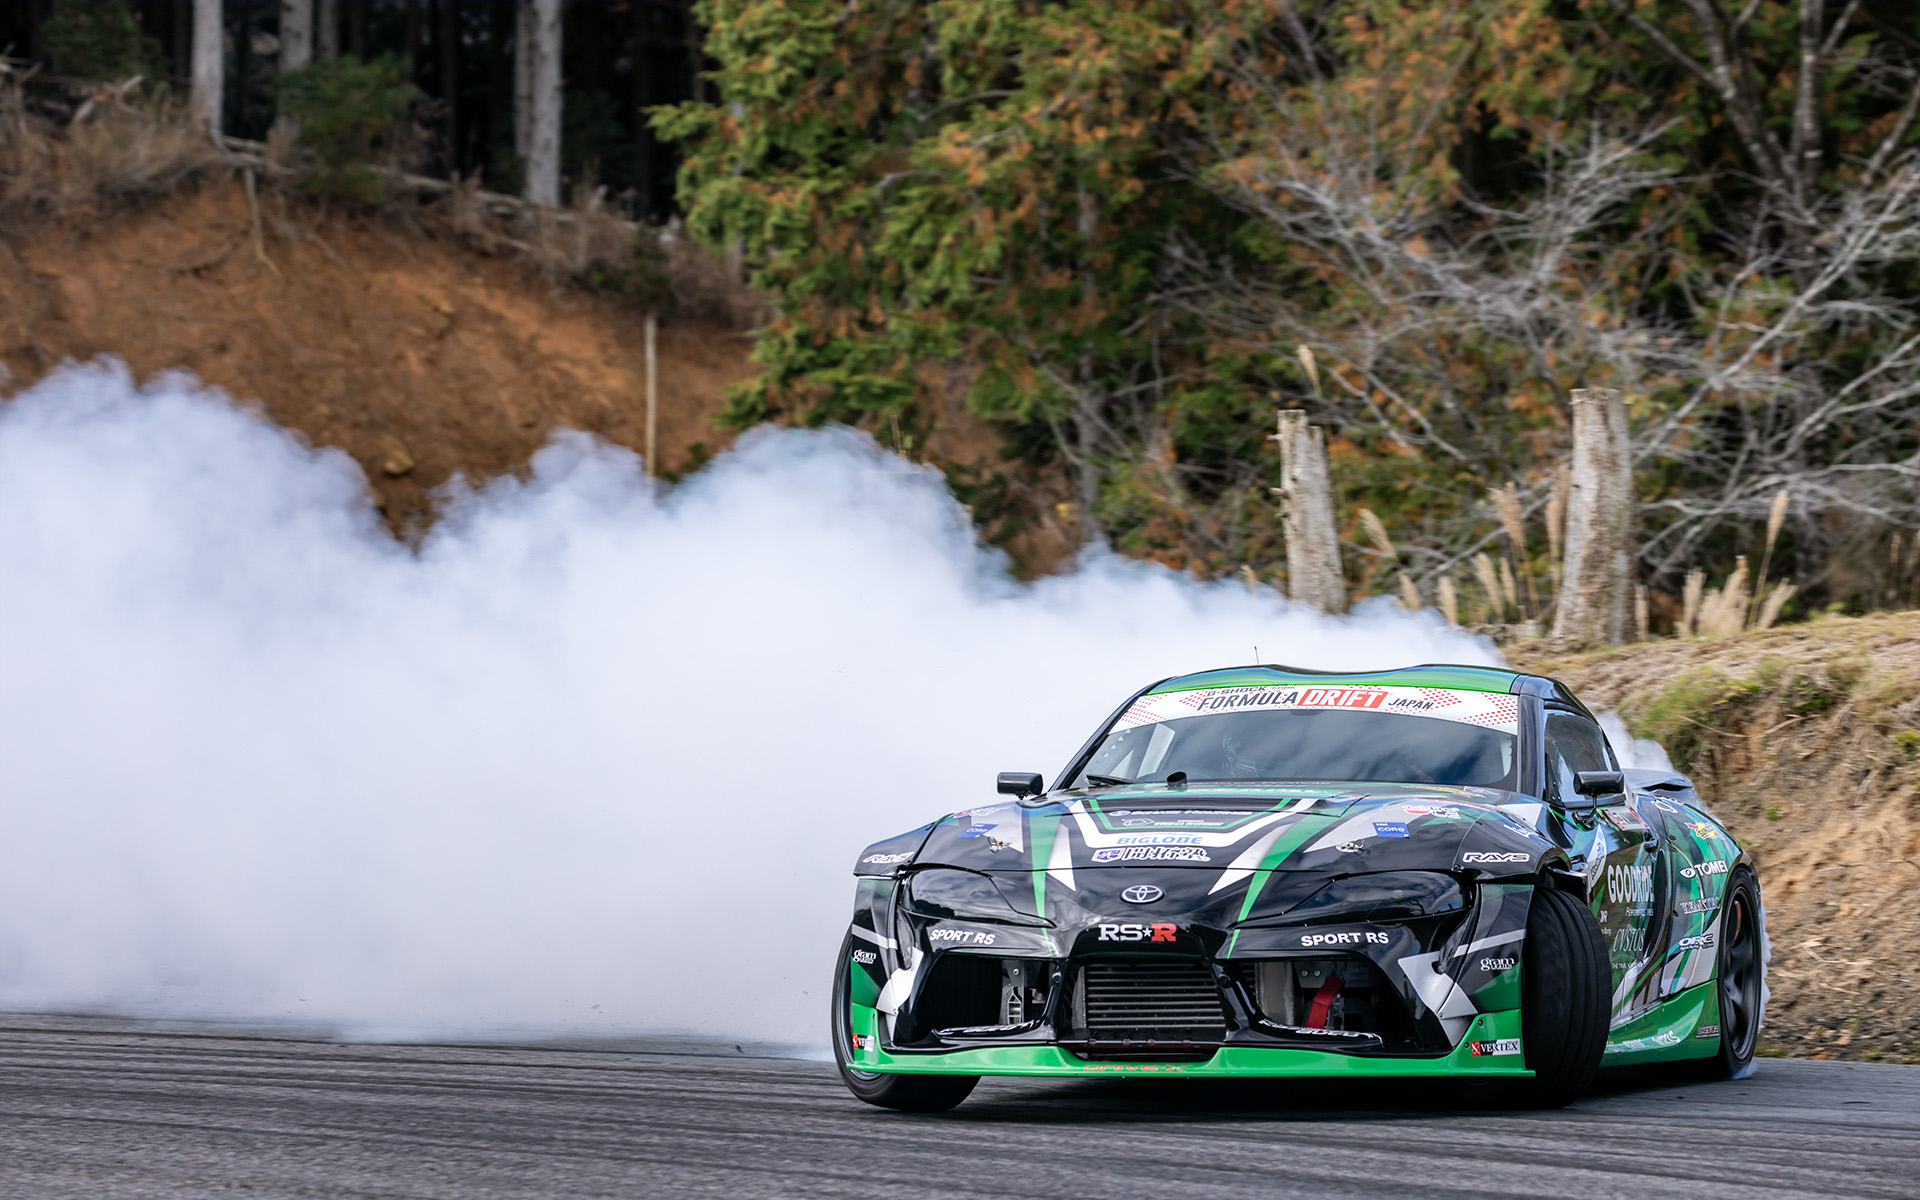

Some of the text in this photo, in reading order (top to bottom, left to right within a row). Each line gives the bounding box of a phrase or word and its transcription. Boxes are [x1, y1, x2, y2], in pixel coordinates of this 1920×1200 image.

[1207, 686, 1266, 696] G-SHOCK
[1197, 689, 1434, 711] FORMULA DRIFT JAPAN
[1117, 836, 1203, 845] BIGLOBE
[1463, 852, 1530, 863] RAYS
[1694, 860, 1728, 876] TOMEI
[930, 929, 996, 945] SPORT RS
[1301, 932, 1389, 947] SPORT RS
[852, 949, 877, 963] gram
[1480, 957, 1515, 971] gram
[1481, 1041, 1518, 1052] VERTEX
